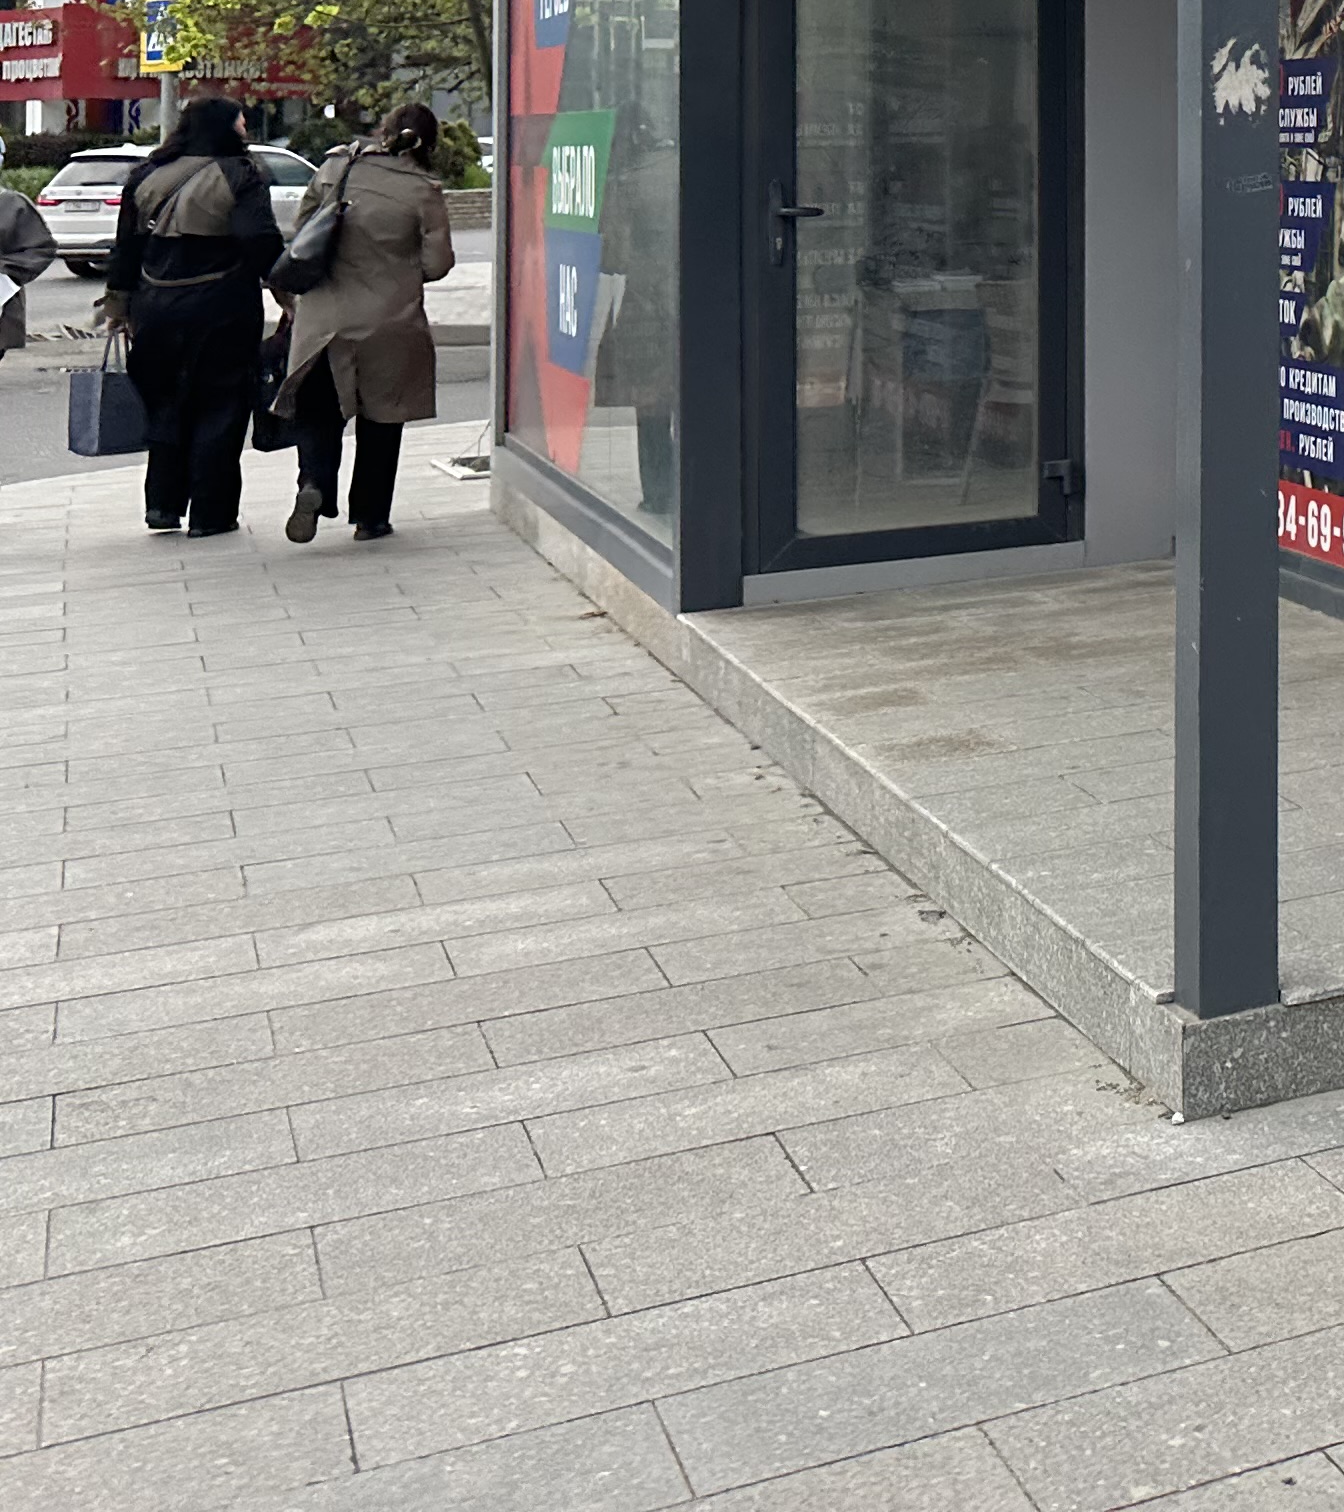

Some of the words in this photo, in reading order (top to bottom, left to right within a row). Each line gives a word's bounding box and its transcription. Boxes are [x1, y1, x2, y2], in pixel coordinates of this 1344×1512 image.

[1288, 71, 1323, 96] РУБЛЕЙ
[1279, 107, 1317, 128] СЛУЖБЫ
[552, 144, 595, 218] ВЫБРАЛО
[1288, 194, 1322, 218] РУБЛЕЙ
[1279, 228, 1305, 249] УЖБЫ
[559, 264, 577, 338] НАС
[1289, 367, 1337, 398] КРЕДИТАМ
[1298, 433, 1334, 463] РУБЛЕЙ
